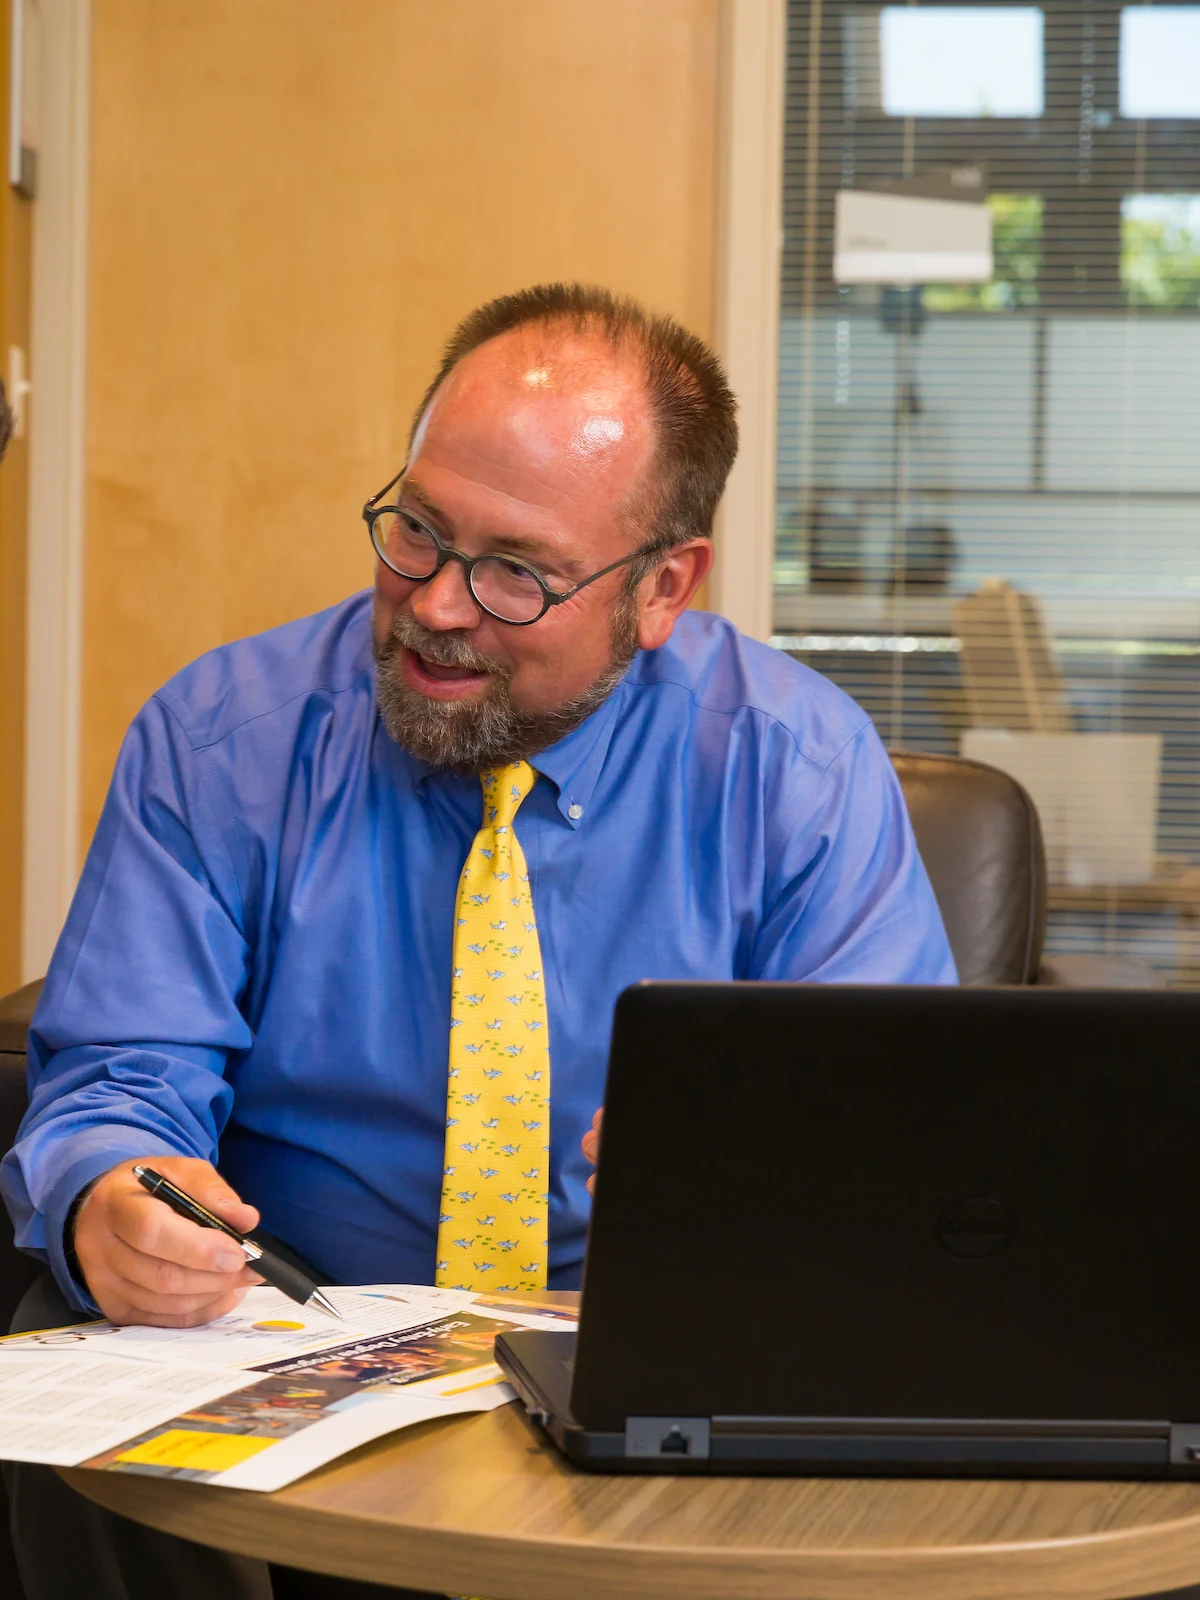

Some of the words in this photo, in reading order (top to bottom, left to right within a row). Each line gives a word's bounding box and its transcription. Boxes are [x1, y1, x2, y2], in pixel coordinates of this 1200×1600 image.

[426, 1320, 471, 1334] Early
[388, 1330, 436, 1344] Entry
[338, 1340, 398, 1357] Degree
